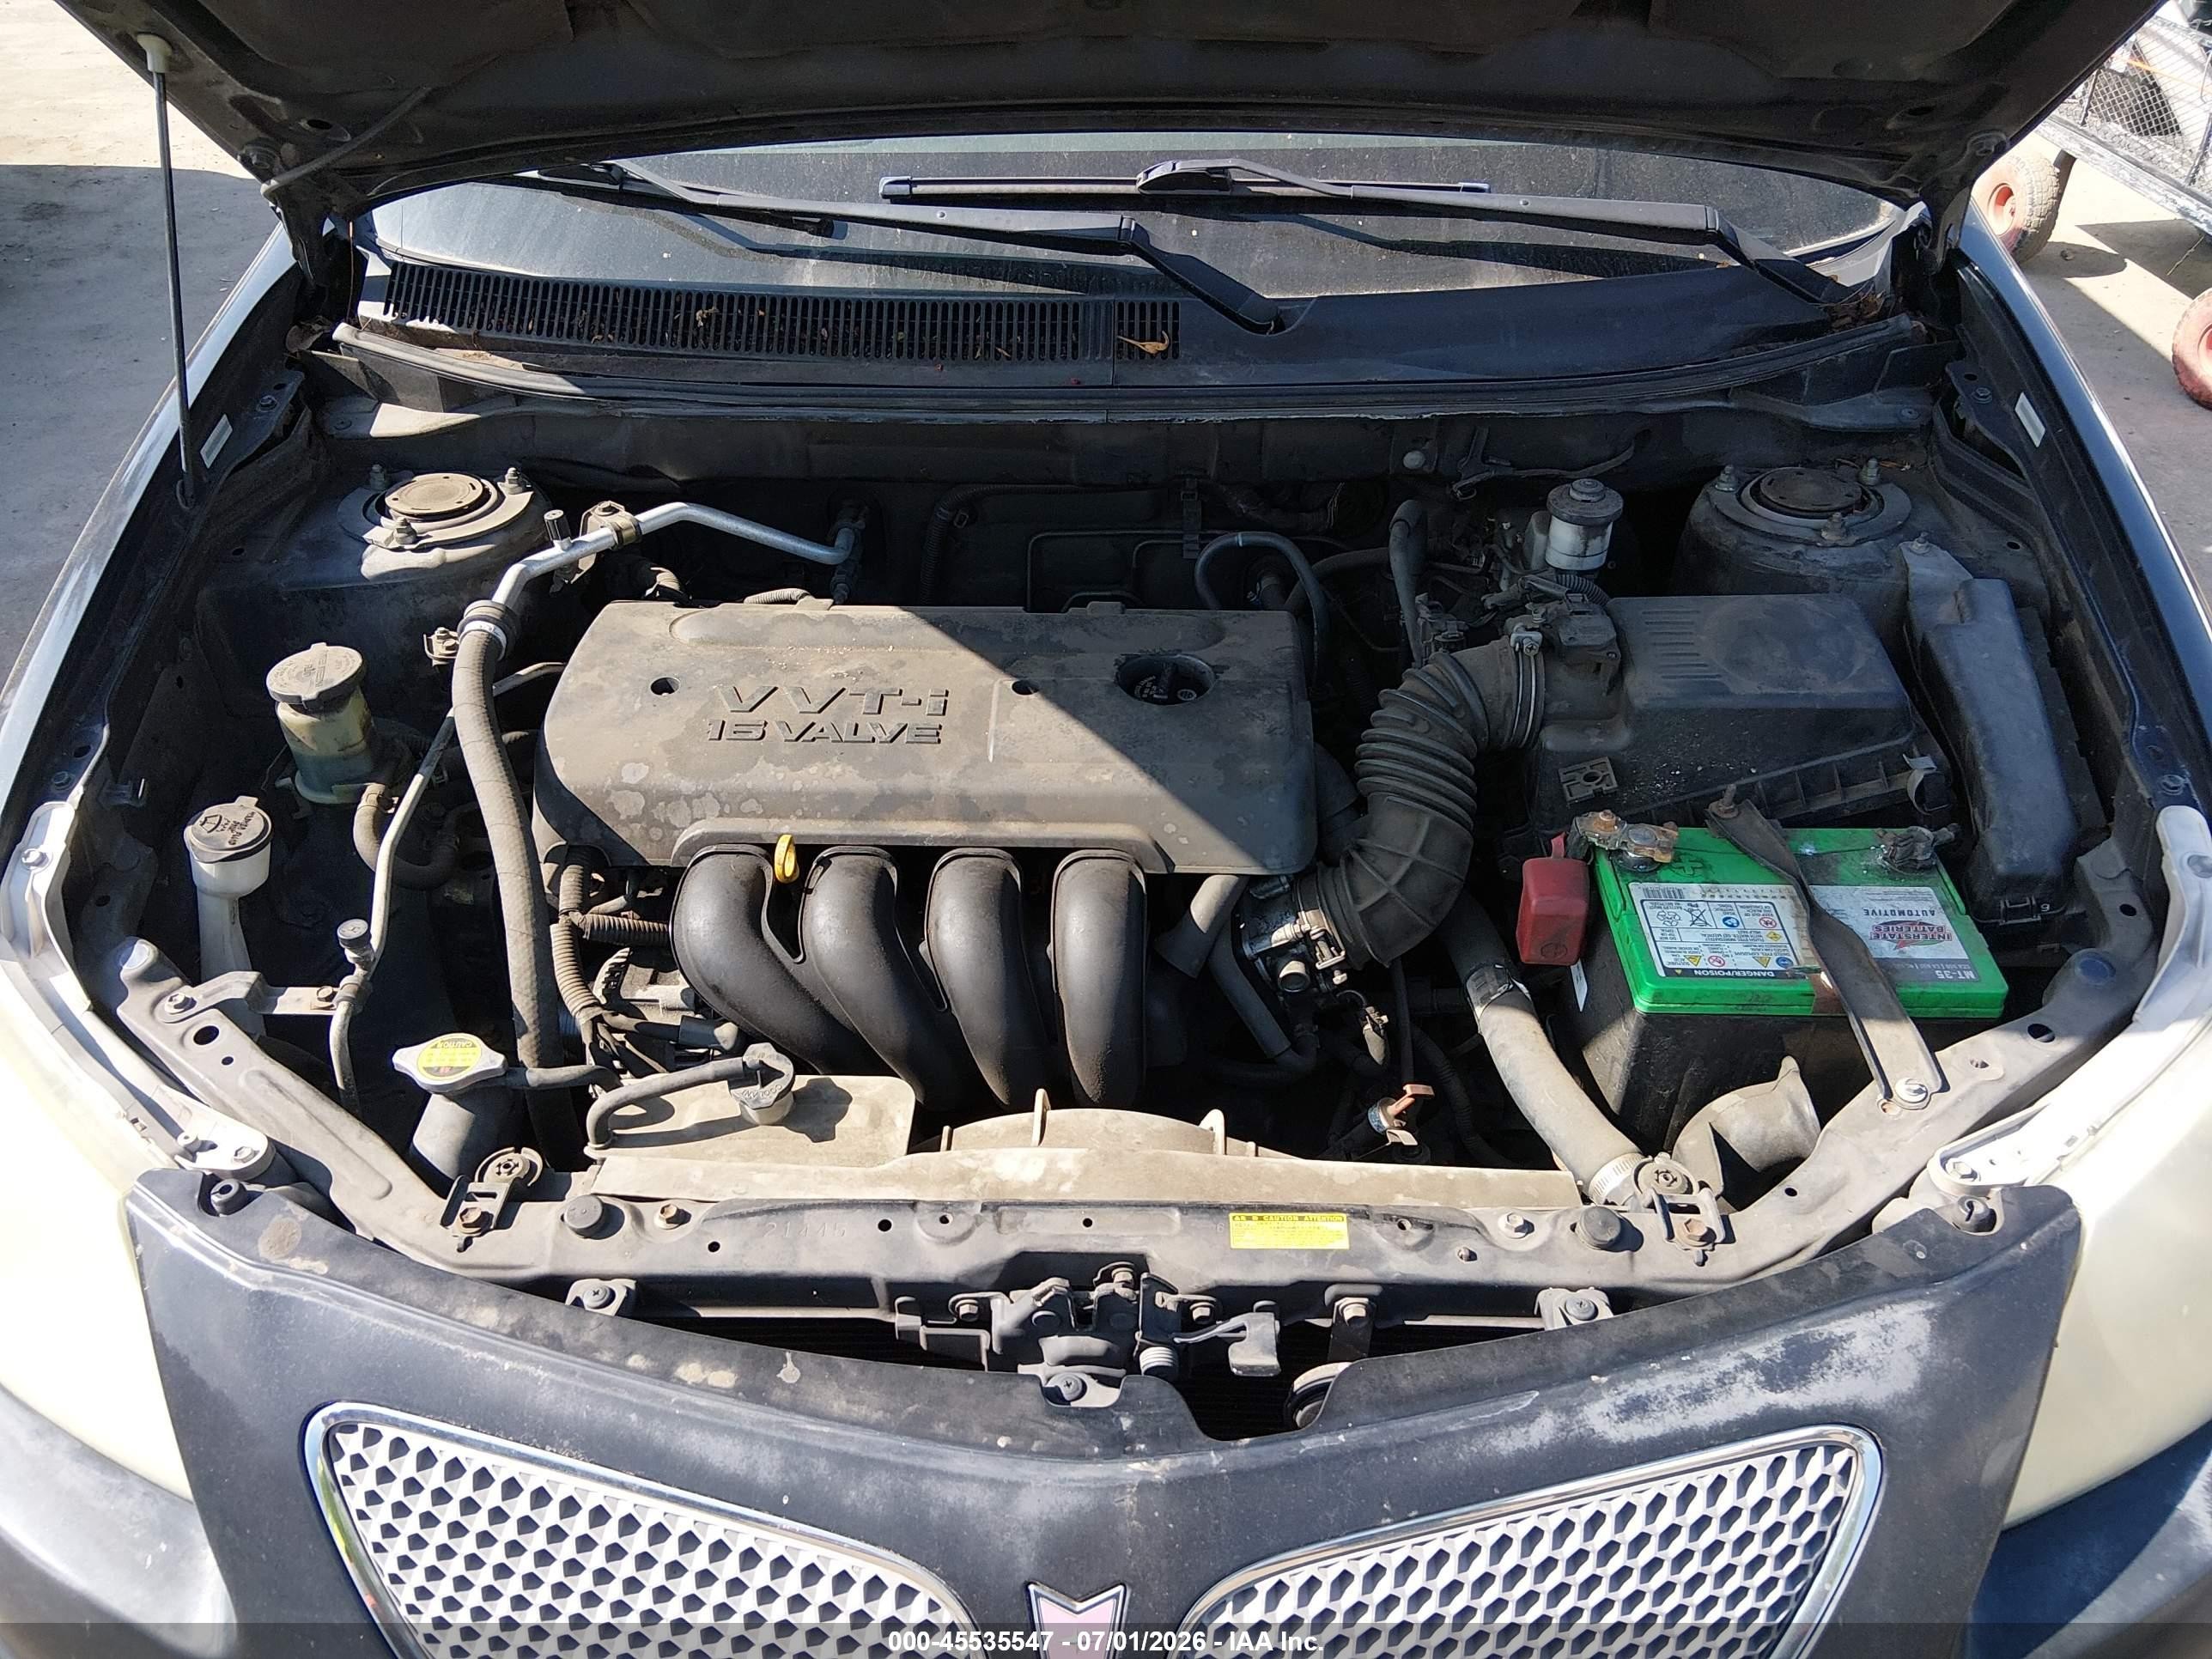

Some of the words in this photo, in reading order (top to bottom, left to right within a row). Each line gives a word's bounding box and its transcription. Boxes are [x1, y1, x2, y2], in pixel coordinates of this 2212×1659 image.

[717, 686, 949, 716] VVT-i
[707, 720, 768, 741] 16
[775, 720, 943, 744] VALVE
[1863, 908, 1936, 917] AUTOMOTIVE
[1935, 969, 1976, 979] MT-35
[435, 1040, 473, 1049] CAUTION
[740, 1084, 783, 1099] COOLANT
